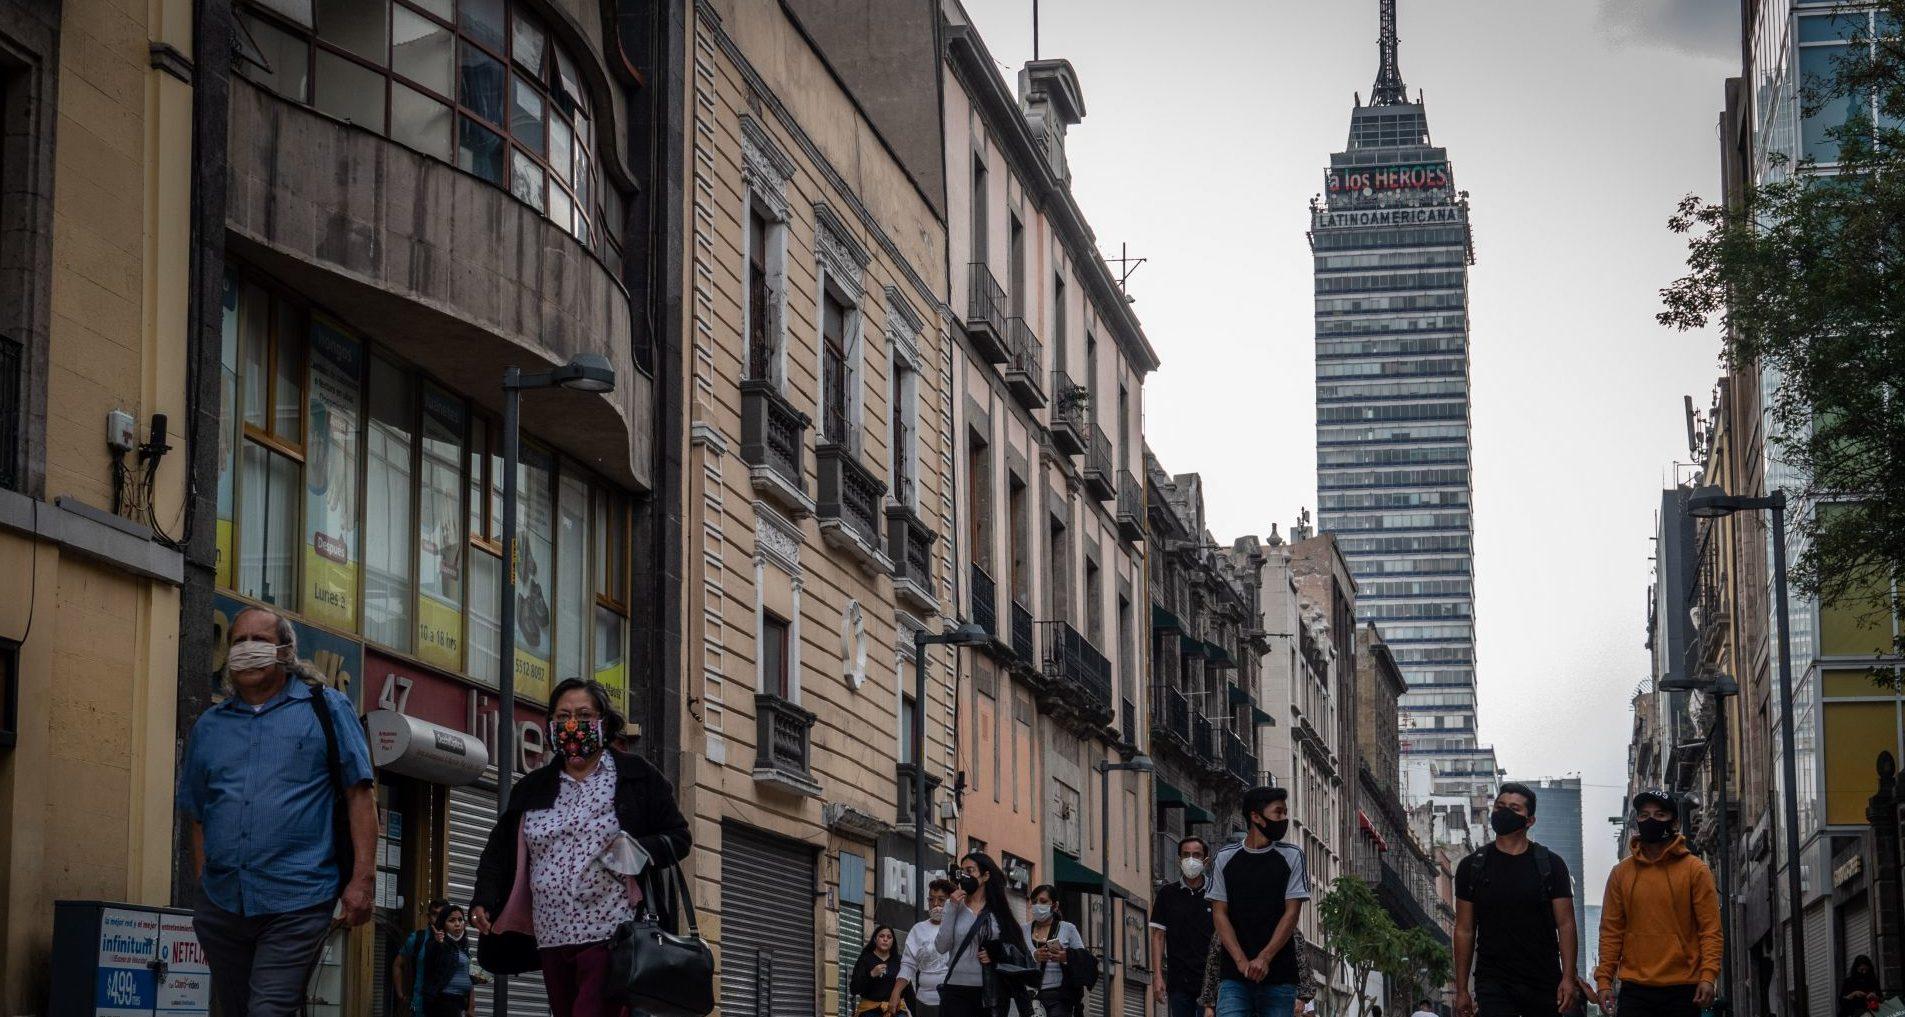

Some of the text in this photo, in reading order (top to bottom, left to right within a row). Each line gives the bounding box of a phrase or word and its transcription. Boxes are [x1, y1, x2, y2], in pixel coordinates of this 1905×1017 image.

[1329, 176, 1340, 191] a
[1345, 168, 1369, 191] los
[1319, 208, 1456, 227] LATINOAMERICANA
[314, 582, 339, 608] Lunes
[420, 623, 428, 641] 10
[378, 673, 414, 713] 47
[110, 917, 124, 927] mejor
[143, 921, 157, 931] mejor
[103, 934, 152, 954] infinitum
[107, 971, 133, 1006] $499
